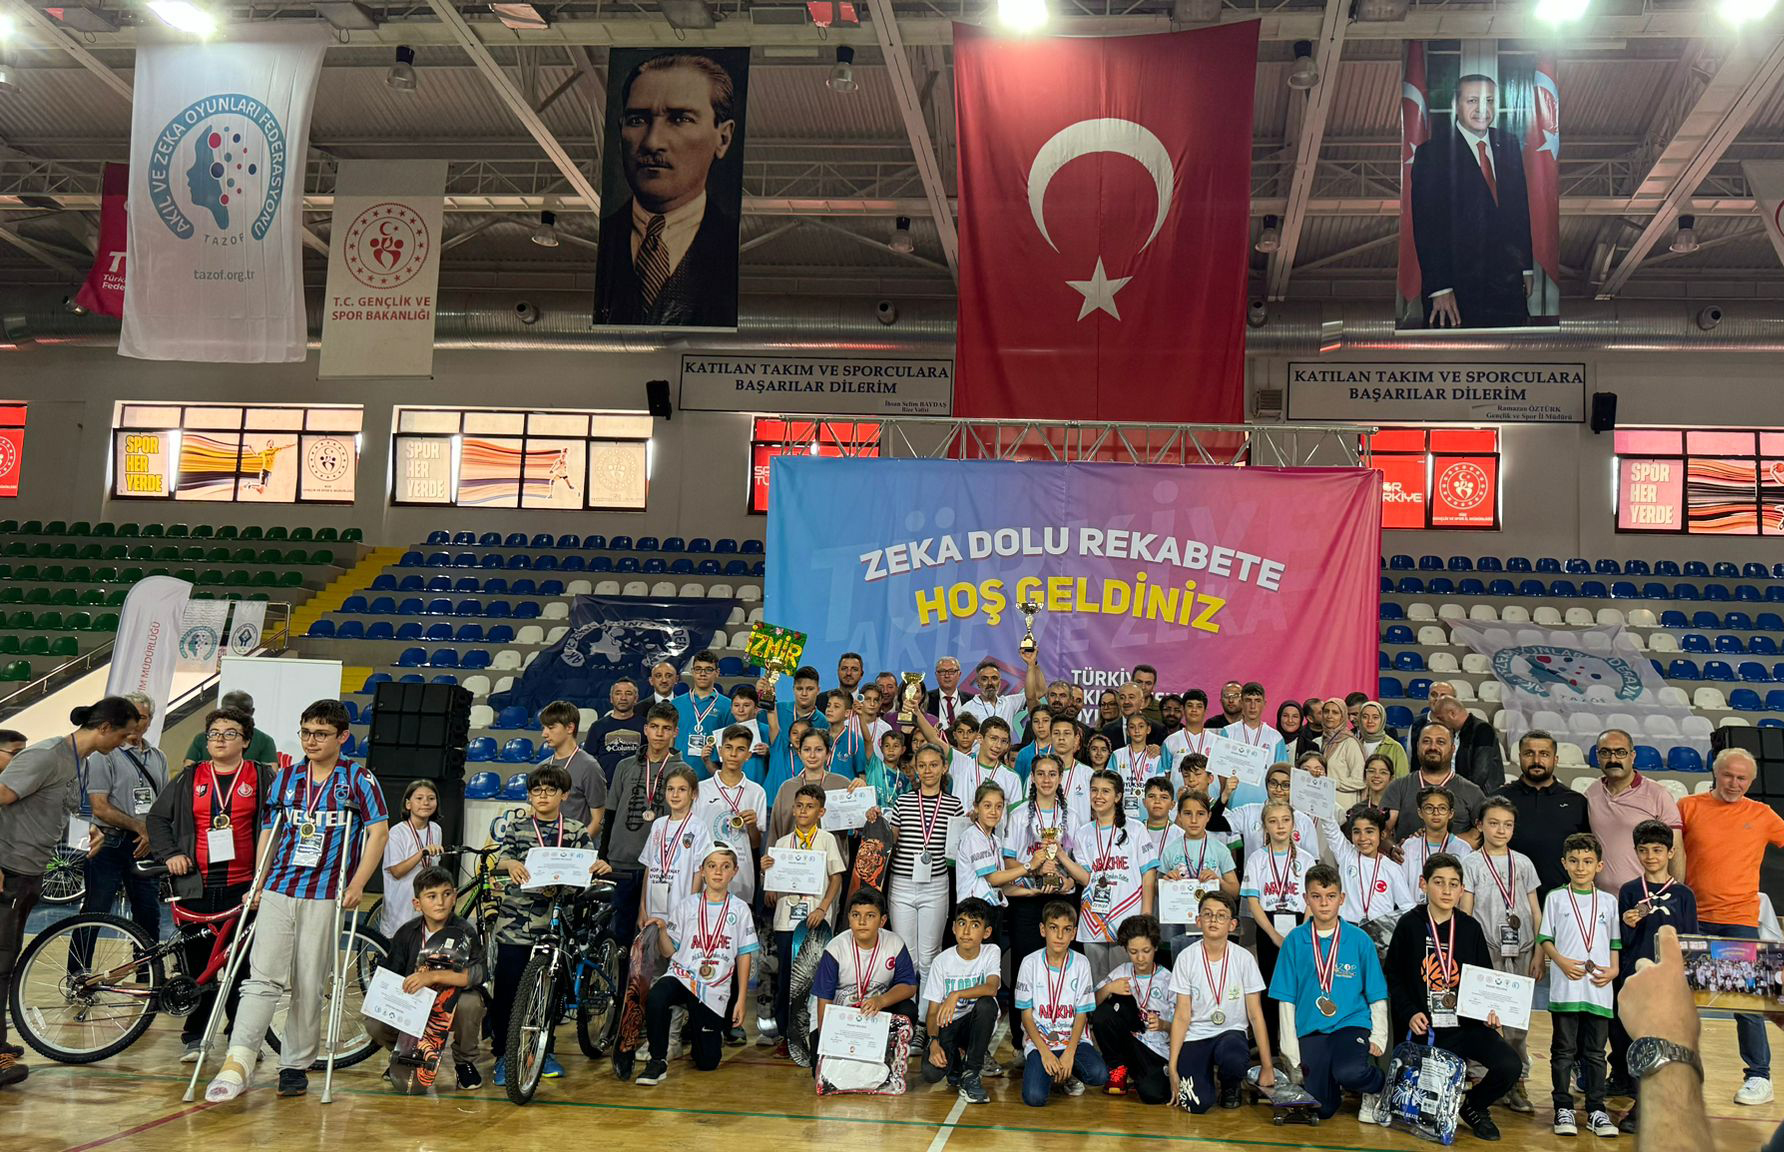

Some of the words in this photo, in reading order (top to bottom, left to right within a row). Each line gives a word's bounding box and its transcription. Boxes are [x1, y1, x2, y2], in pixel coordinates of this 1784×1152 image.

[185, 96, 261, 124] OYUNLARI
[154, 123, 187, 165] ZEKA
[152, 169, 168, 193] VE
[258, 112, 284, 237] FEDERASYONU
[162, 195, 190, 233] AKIL
[203, 233, 247, 246] TAZOF
[193, 268, 256, 283] tazof.org.tr
[333, 296, 354, 307] T.C.
[358, 294, 411, 309] GENÇLİK
[416, 296, 431, 307] VE
[332, 310, 363, 321] SPOR
[366, 308, 430, 321] BAKANLIĞI
[684, 362, 756, 375] KATILAN
[760, 364, 814, 376] TAKIM
[818, 365, 839, 376] VE
[842, 365, 949, 378] SPORCULARA
[1294, 369, 1371, 383] KATILAN
[1375, 370, 1434, 383] TAKIM
[1438, 370, 1462, 383] VE
[1465, 370, 1584, 384] SPORCULARA
[735, 379, 825, 394] BAŞARILAR
[829, 380, 898, 394] DİLERİM
[1349, 387, 1447, 402] BAŞARILAR
[1452, 385, 1527, 401] DİLERİM
[125, 435, 160, 454] SPOR
[406, 441, 440, 460] SPOR
[125, 454, 150, 473] HER
[406, 460, 431, 479] HER
[1630, 462, 1671, 483] SPOR
[125, 473, 163, 493] YERDE
[406, 478, 445, 498] YERDE
[1630, 483, 1658, 503] HER
[1630, 504, 1674, 524] YERDE
[860, 535, 963, 582] ZEKA
[967, 527, 1069, 559] DOLU
[1079, 527, 1286, 592] REKABETE
[914, 578, 1007, 627] HOŞ
[1015, 571, 1227, 634] GELDİNİZ
